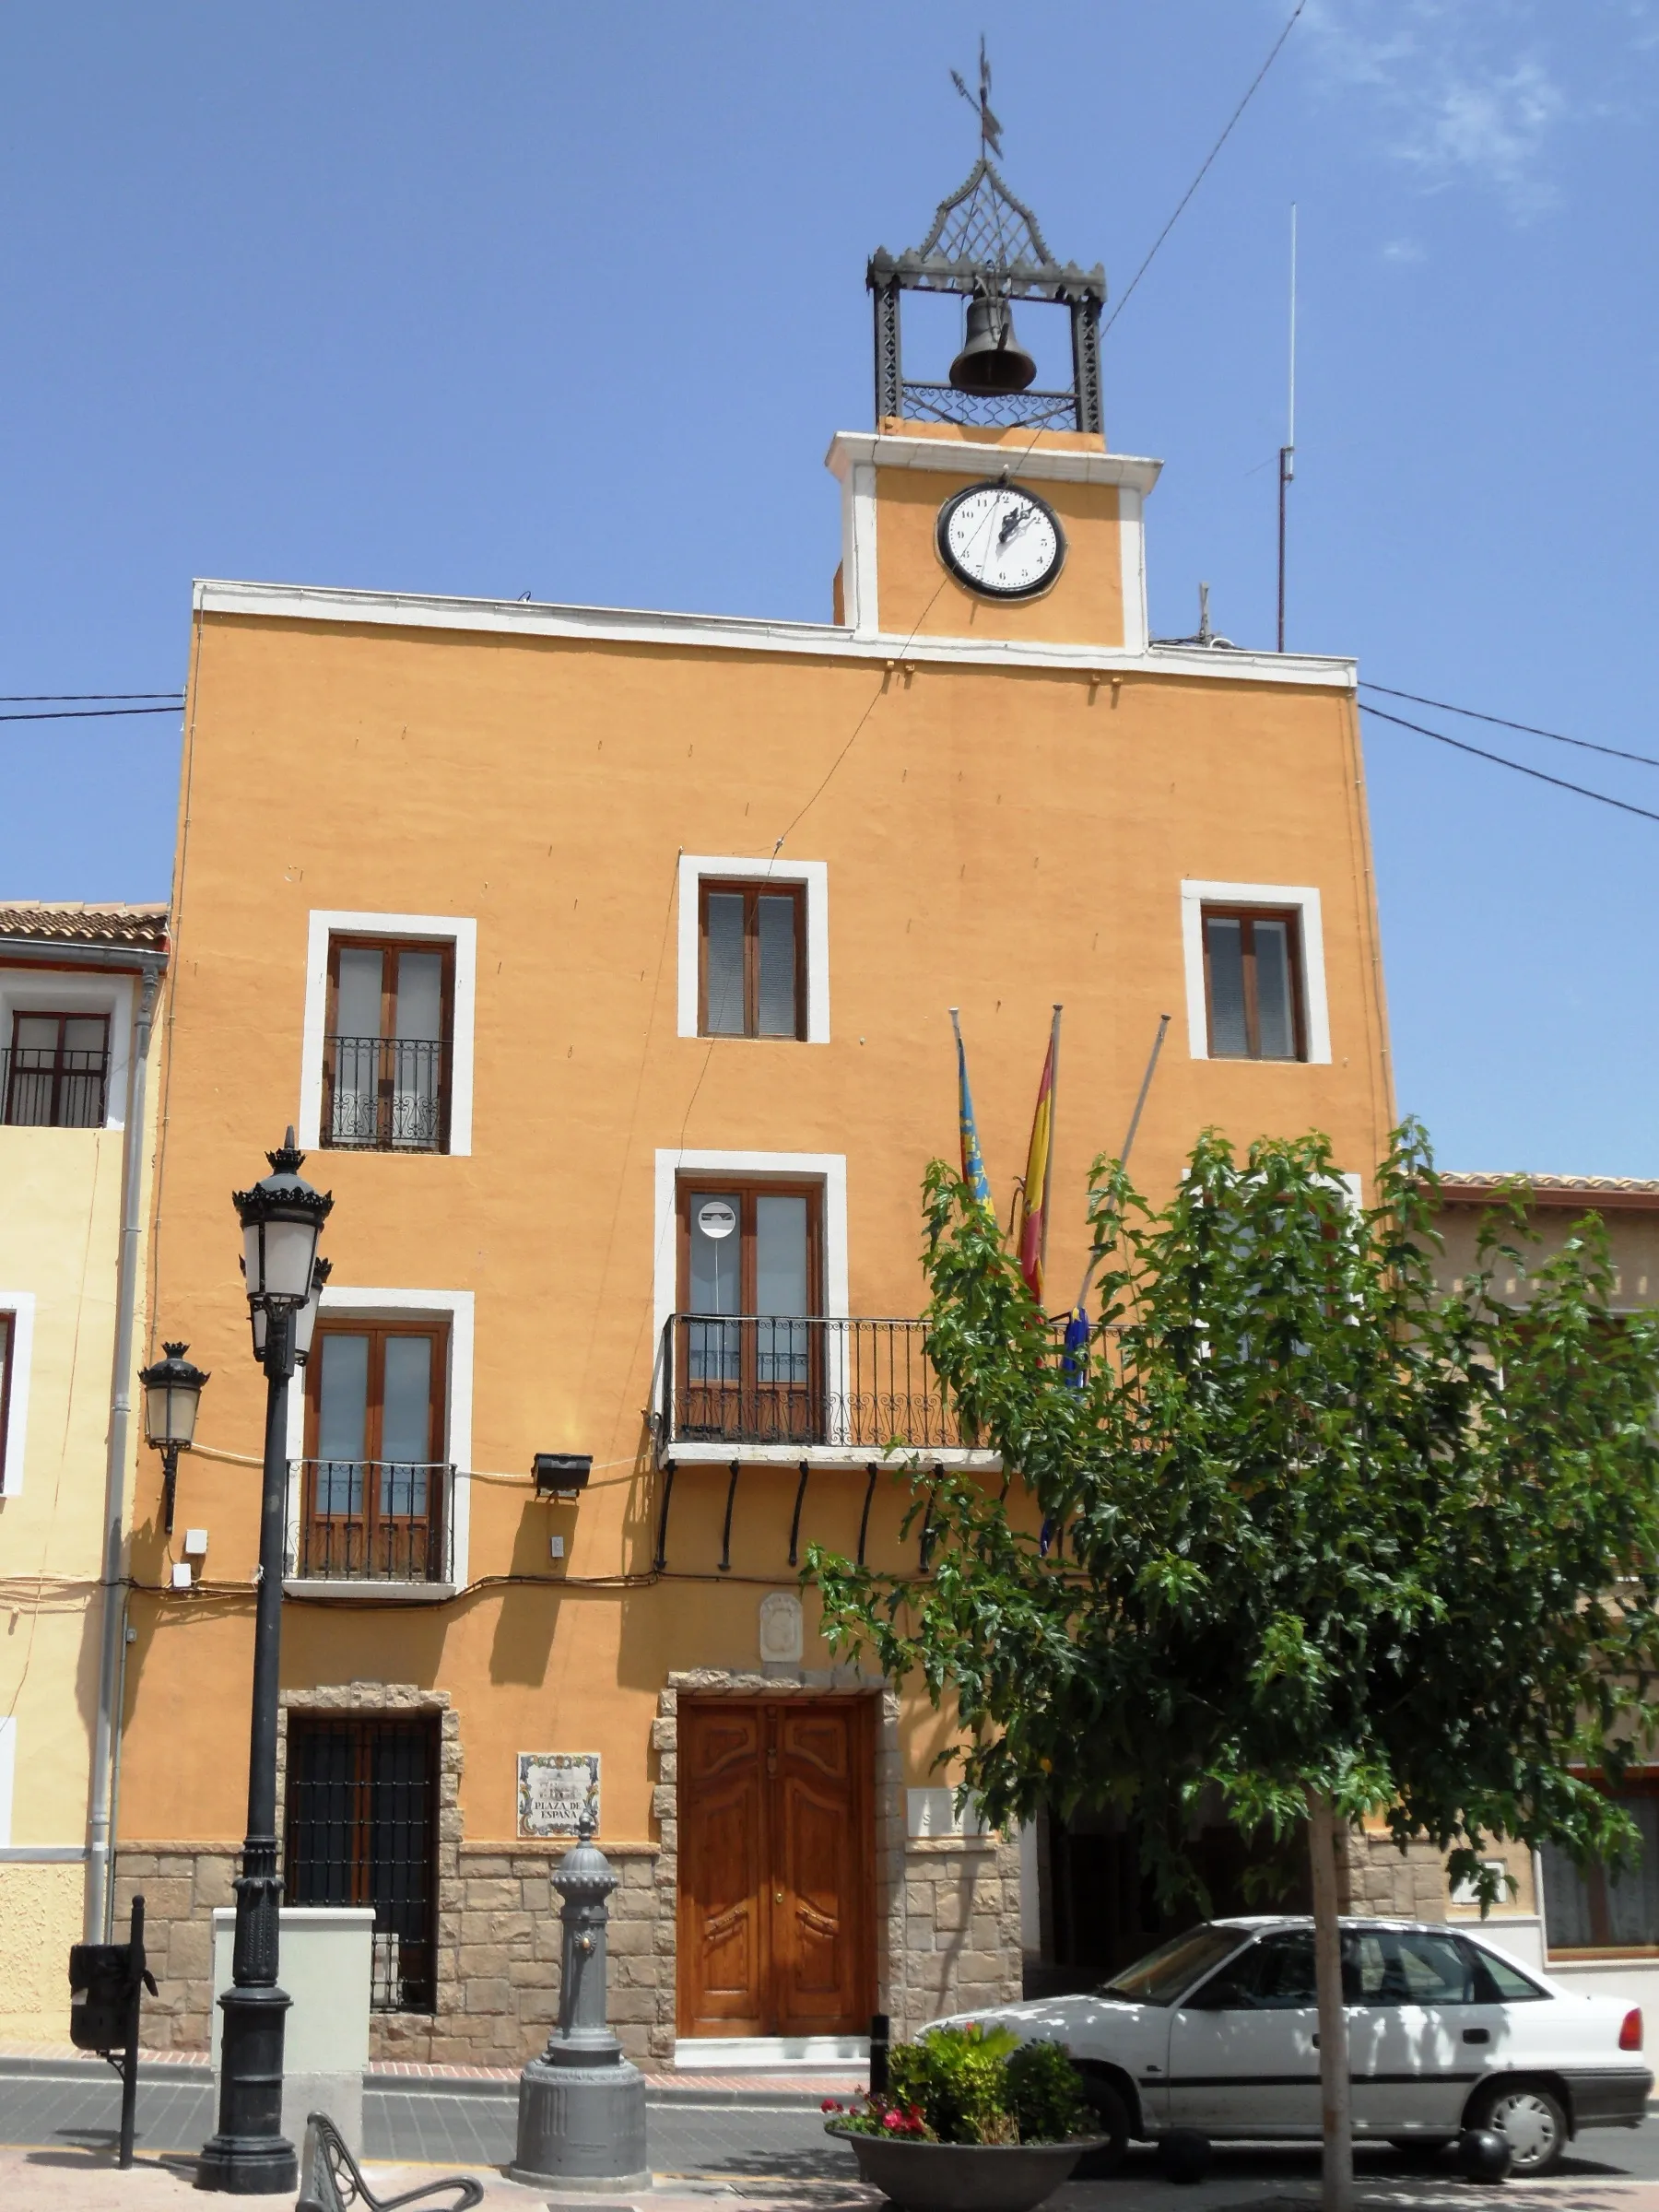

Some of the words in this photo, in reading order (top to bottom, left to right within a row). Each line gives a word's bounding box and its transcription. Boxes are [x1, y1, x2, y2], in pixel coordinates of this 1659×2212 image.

[978, 499, 987, 507] 11
[1041, 538, 1048, 547] 3
[1036, 556, 1043, 564] 4
[976, 565, 982, 573] 7
[1021, 569, 1029, 577] 5
[999, 571, 1006, 580] 6
[535, 1802, 567, 1810] PLAZA
[570, 1802, 581, 1810] DE
[541, 1809, 577, 1818] ESPAÑA
